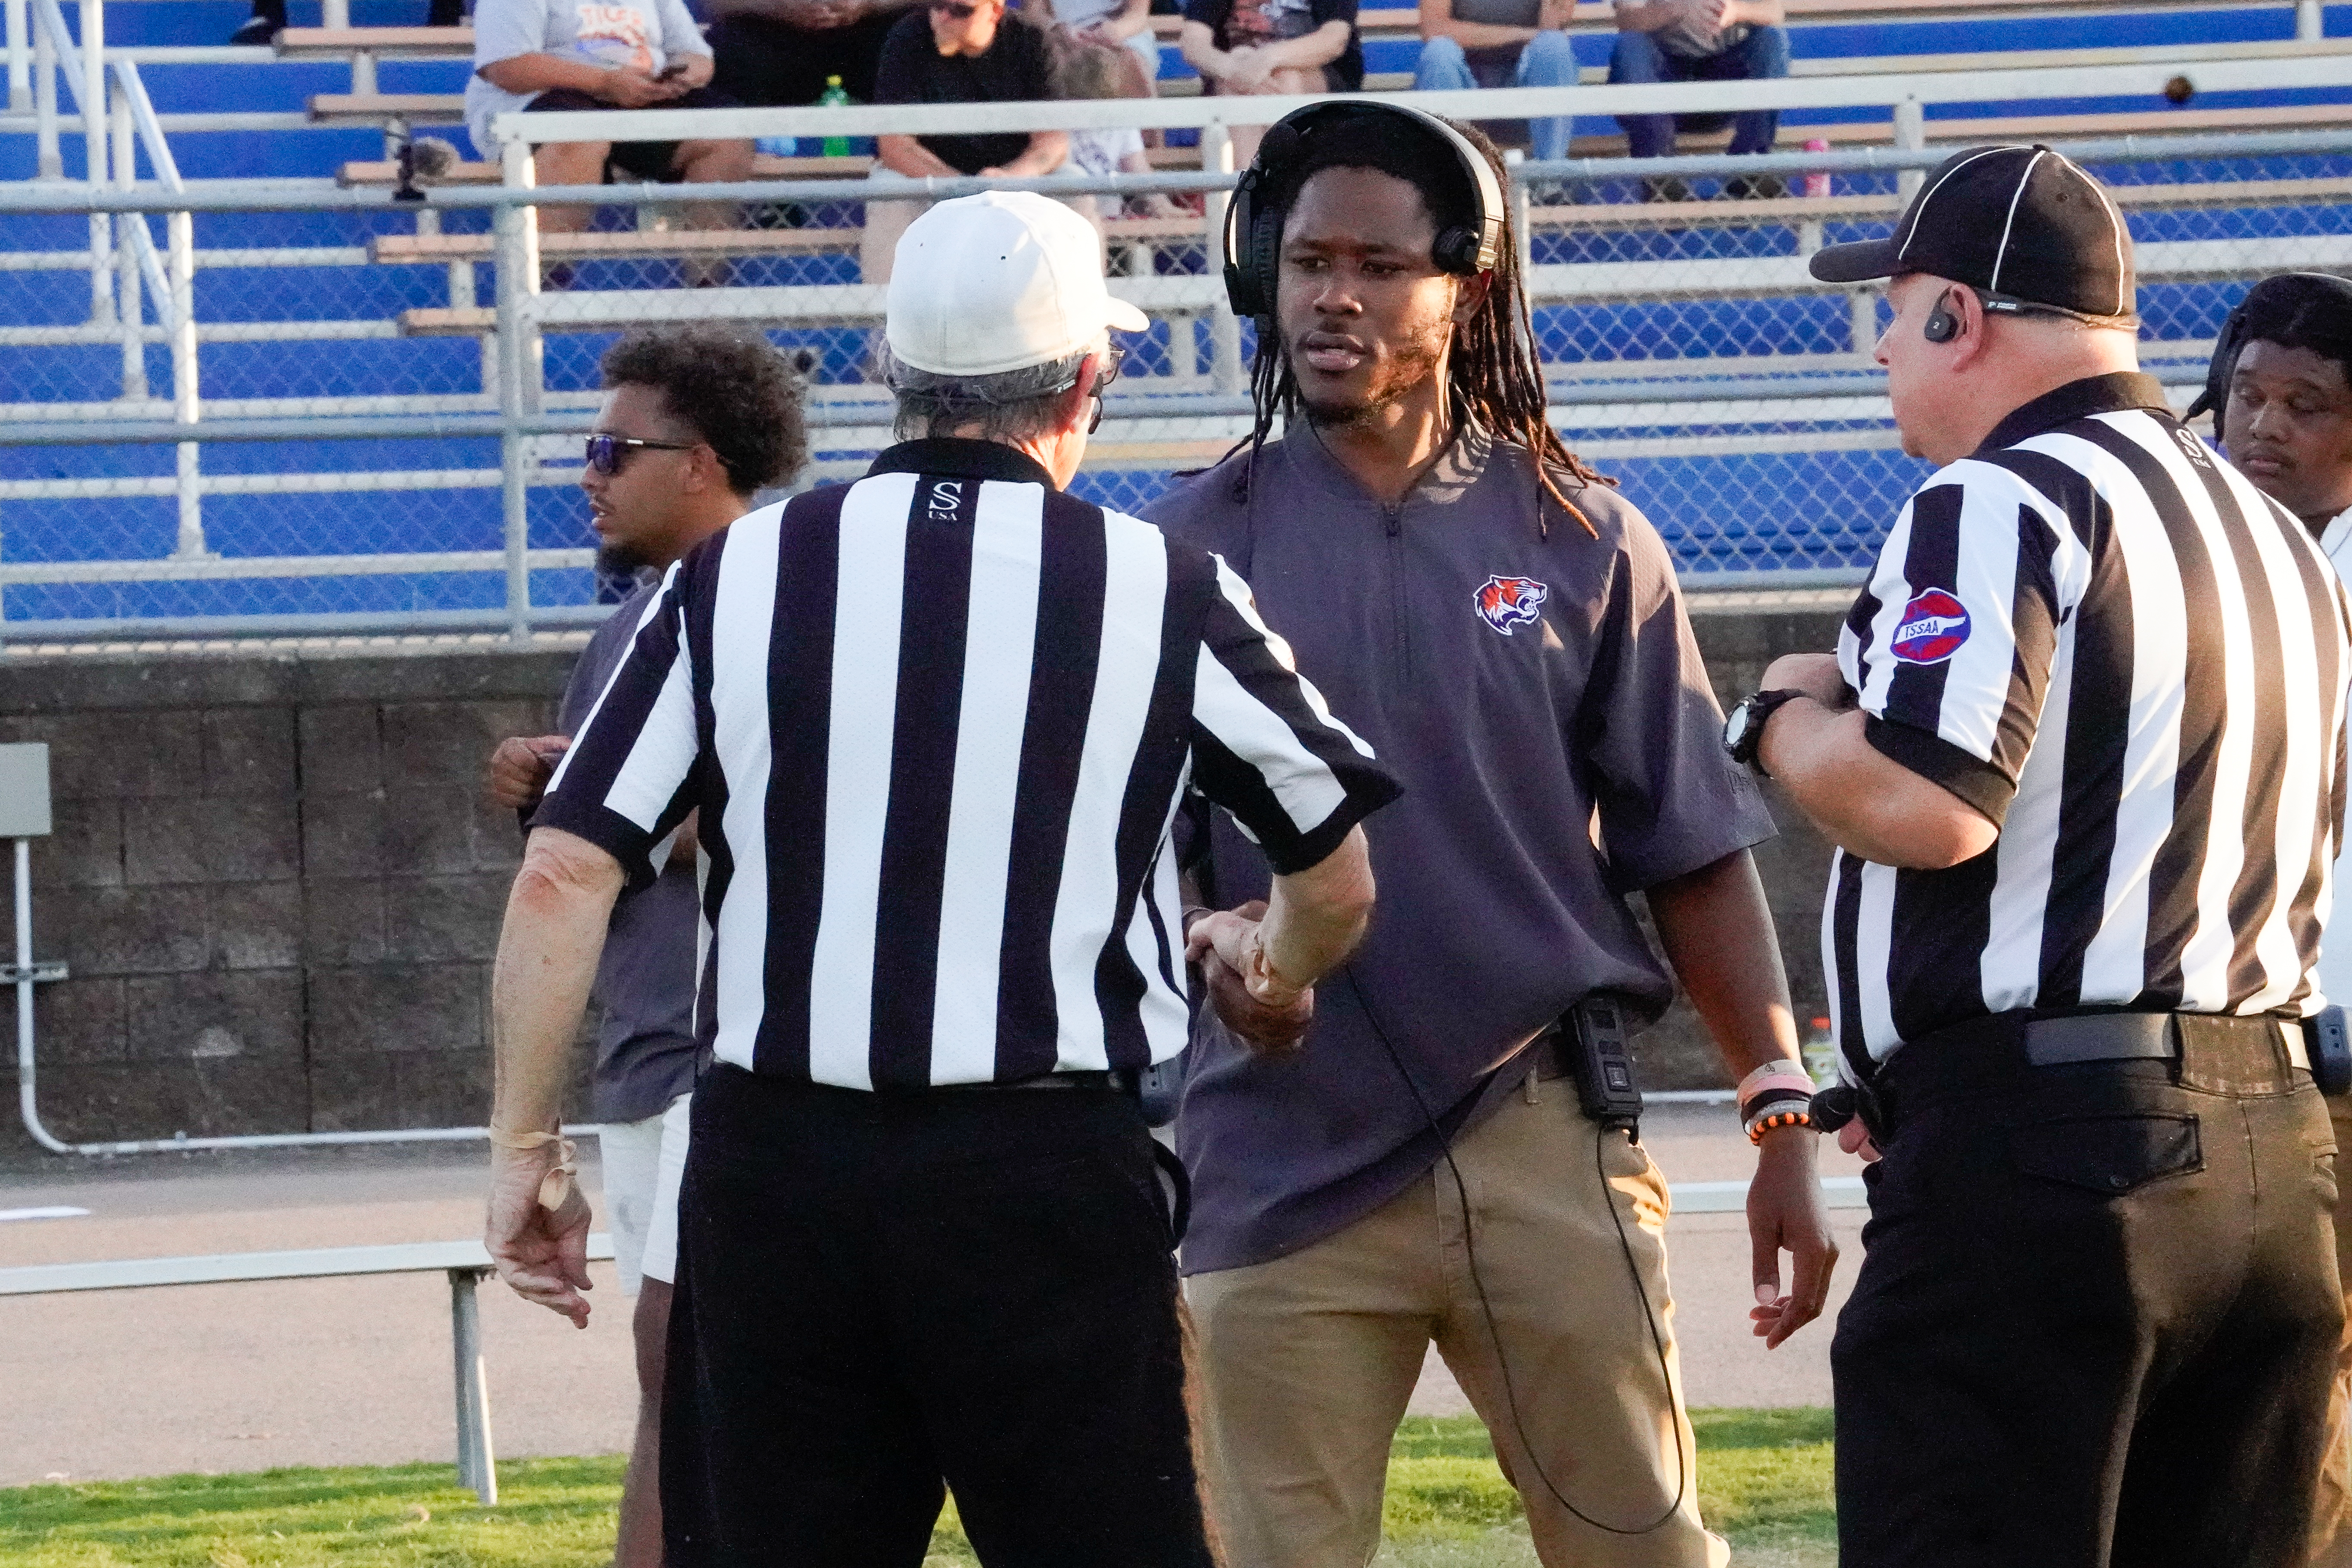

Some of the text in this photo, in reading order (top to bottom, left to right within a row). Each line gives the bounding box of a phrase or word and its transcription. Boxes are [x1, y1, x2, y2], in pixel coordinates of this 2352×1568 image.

[2176, 428, 2203, 458] S
[929, 482, 962, 510] S
[929, 511, 957, 521] USA
[1905, 620, 1939, 638] TSSAA
